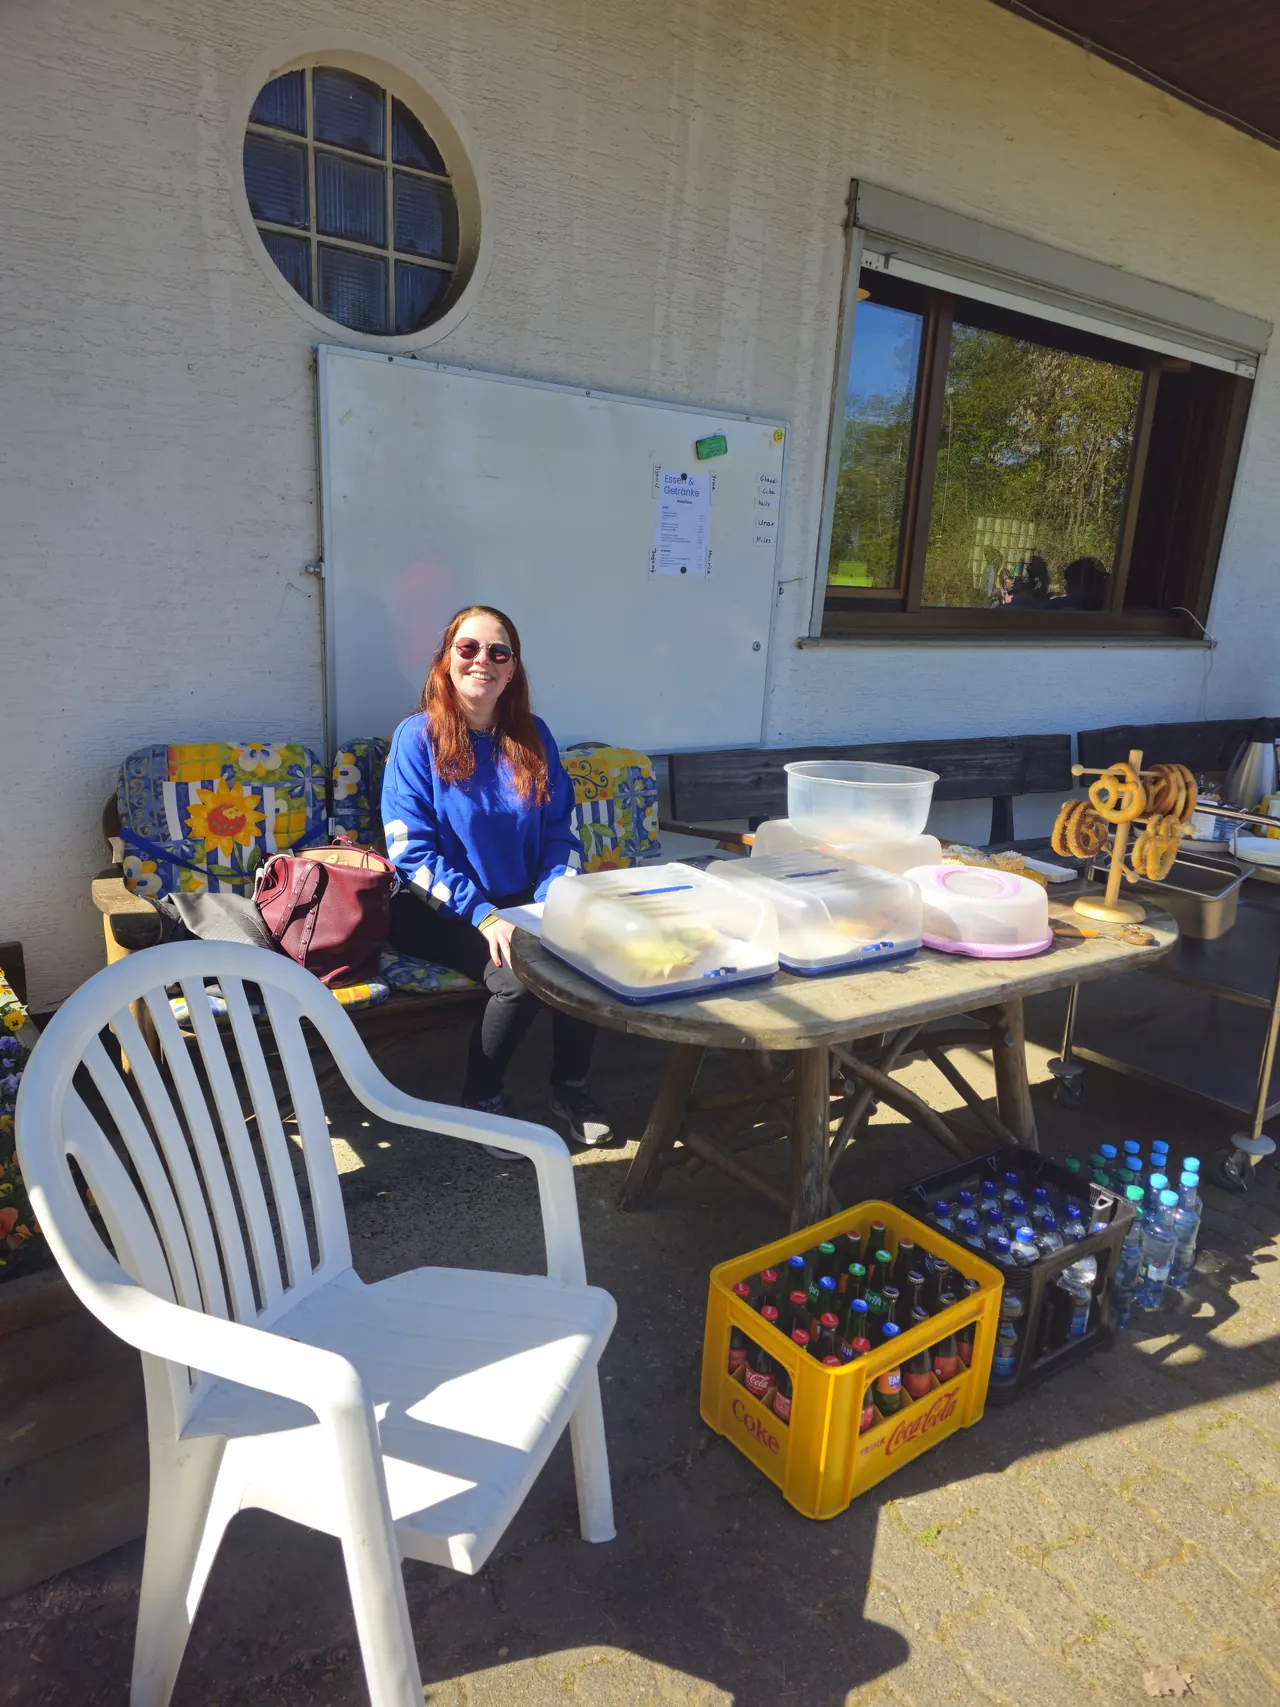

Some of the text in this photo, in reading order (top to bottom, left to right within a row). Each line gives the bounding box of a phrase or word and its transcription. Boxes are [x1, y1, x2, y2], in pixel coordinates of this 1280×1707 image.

[664, 474, 695, 486] Essen &
[663, 485, 700, 498] Getränke
[732, 1399, 780, 1455] Coke
